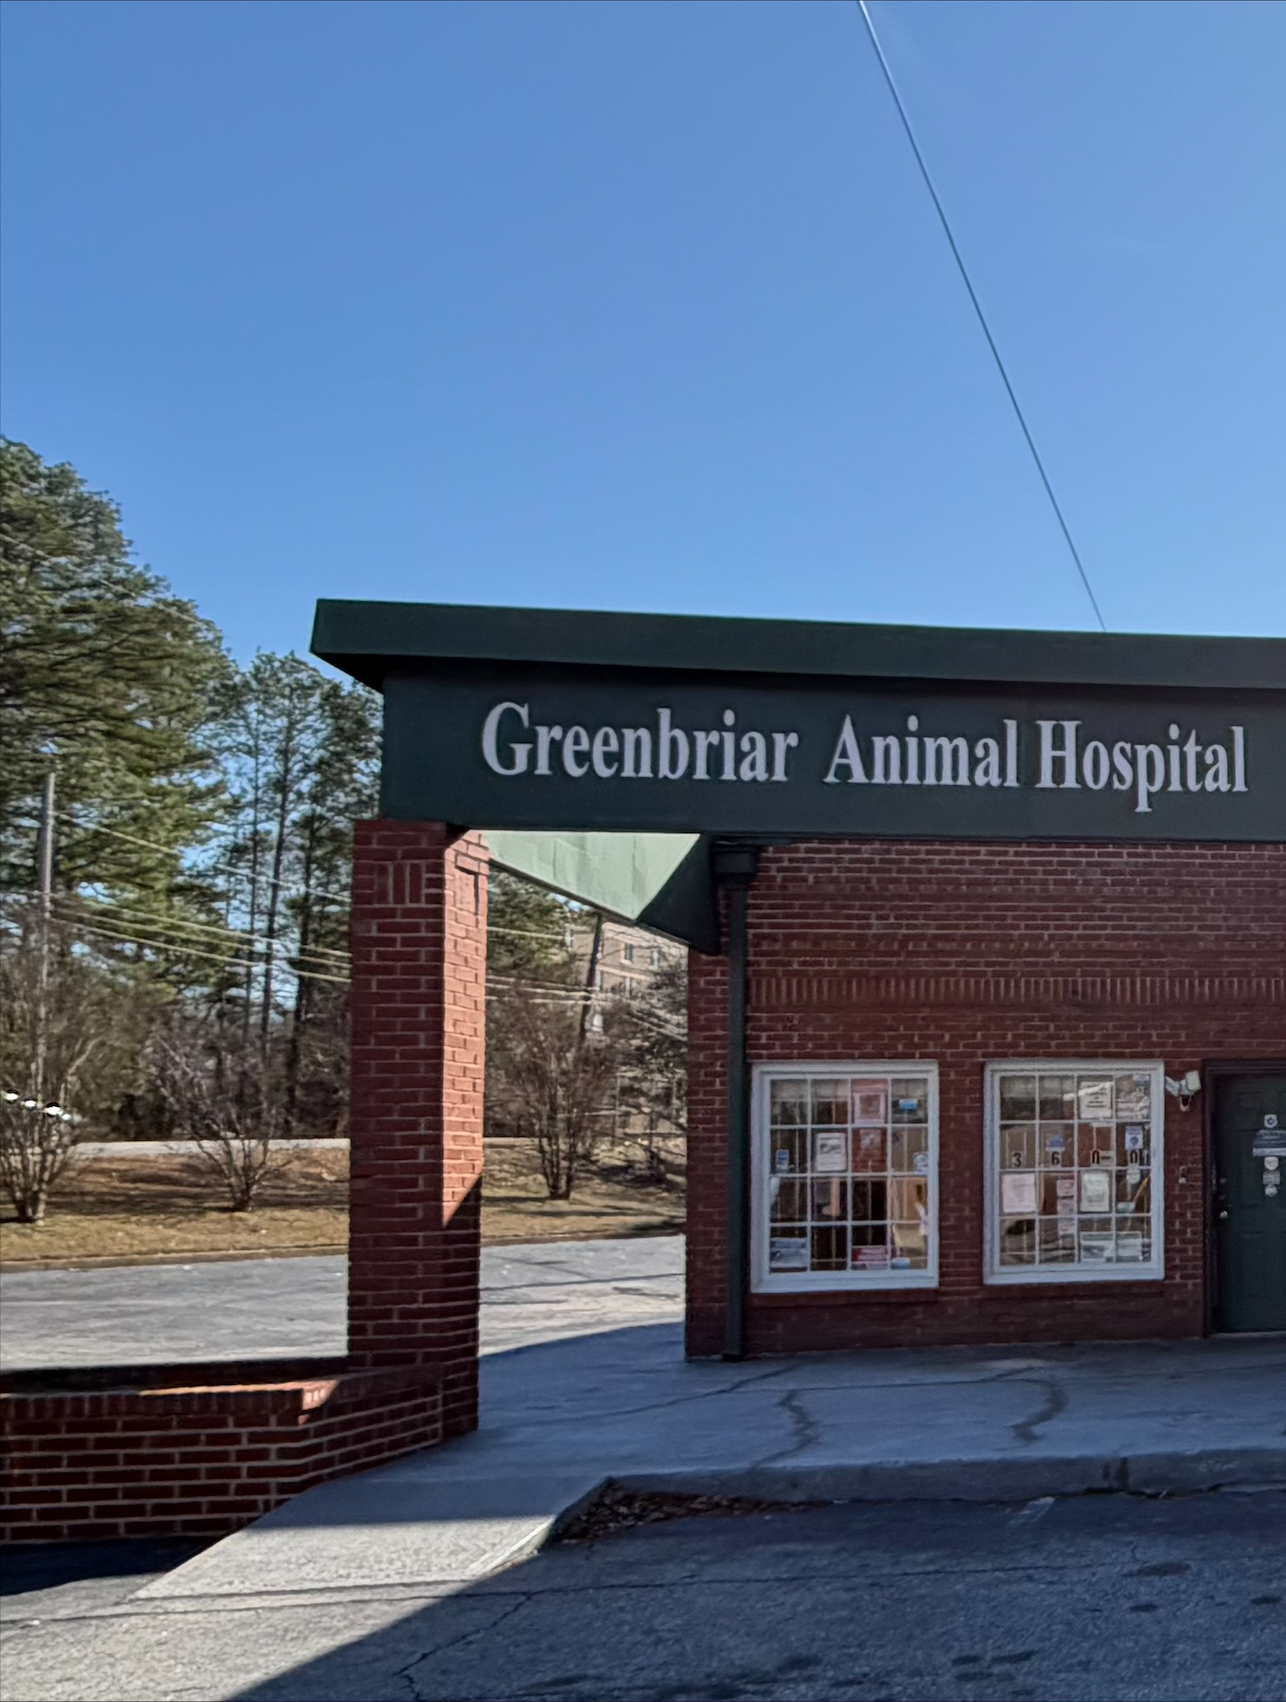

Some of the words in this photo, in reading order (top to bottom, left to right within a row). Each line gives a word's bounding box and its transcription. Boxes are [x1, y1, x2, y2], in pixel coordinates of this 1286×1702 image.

[482, 701, 799, 782] Greenbriar
[823, 714, 1021, 788] Animal
[1034, 719, 1249, 813] Hospital
